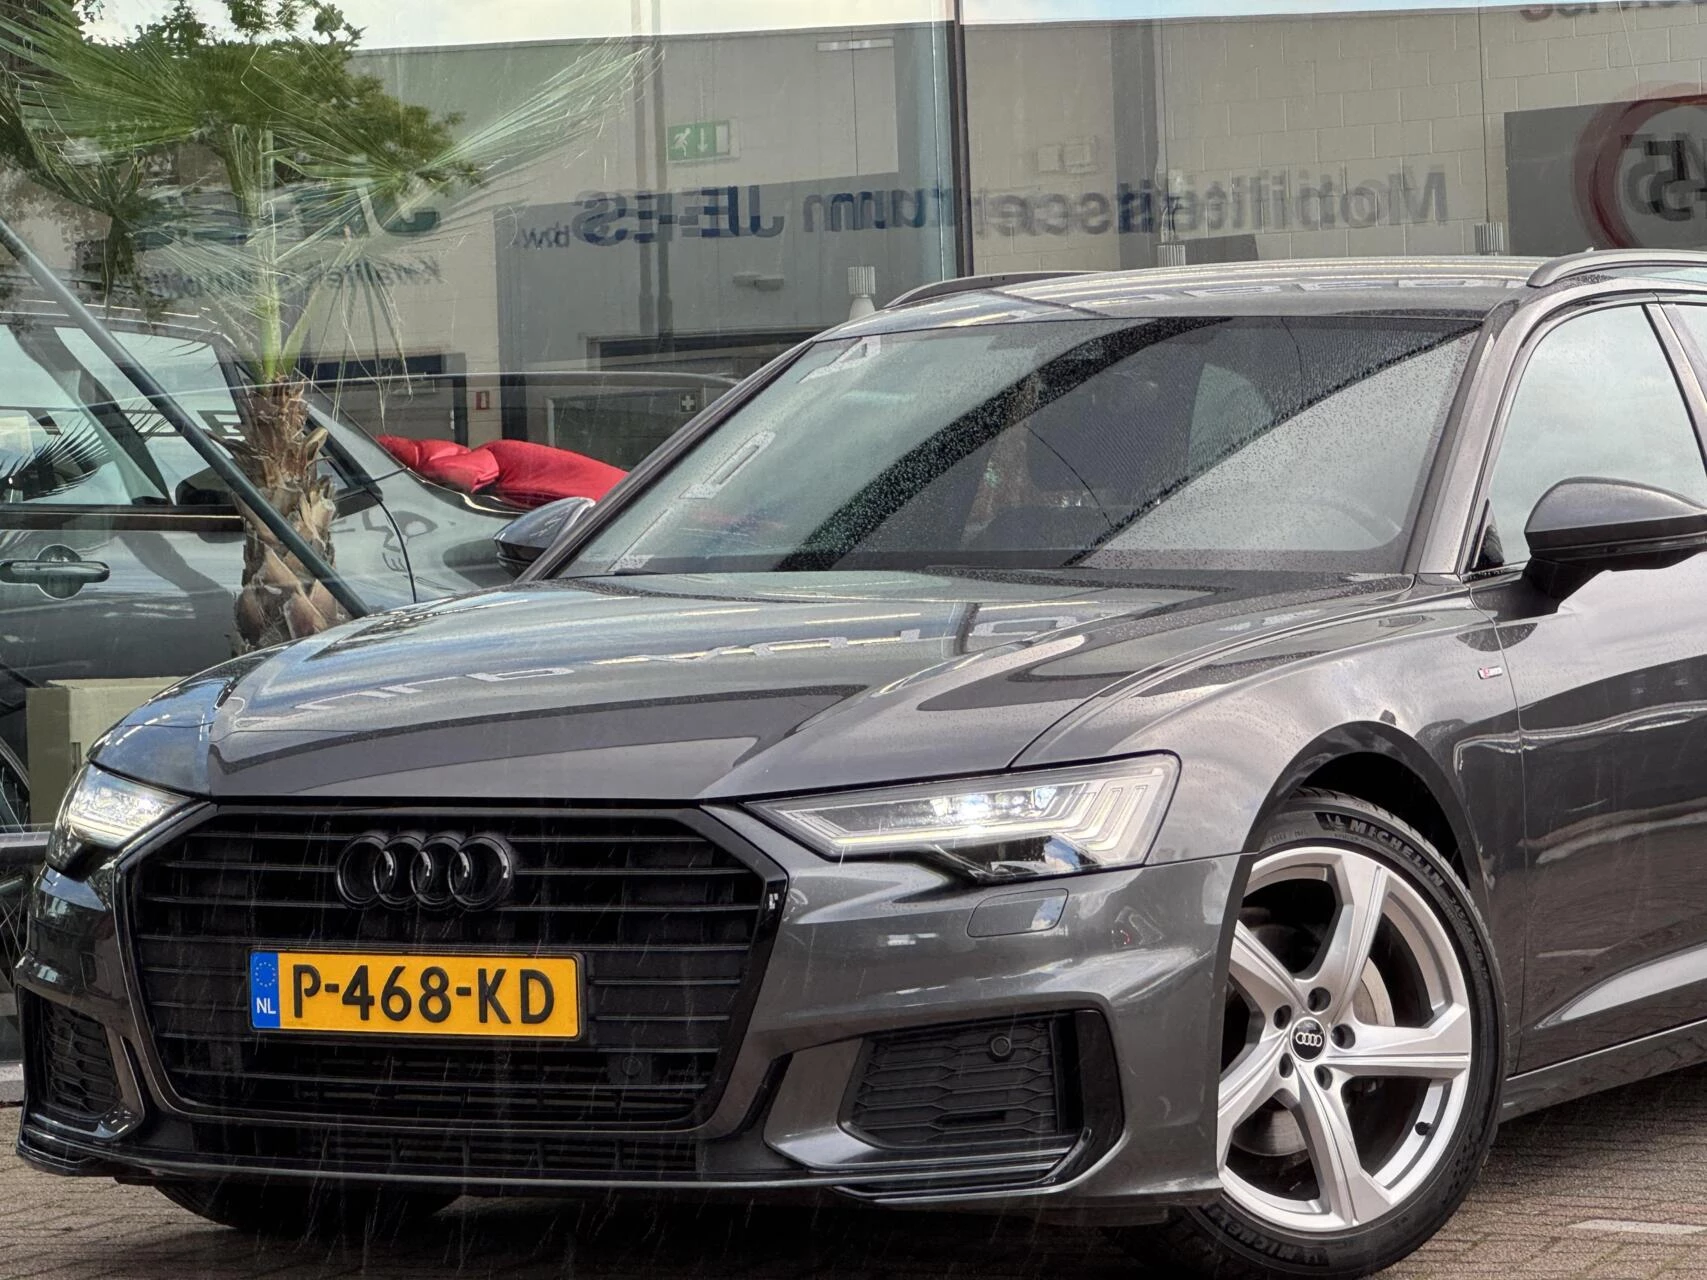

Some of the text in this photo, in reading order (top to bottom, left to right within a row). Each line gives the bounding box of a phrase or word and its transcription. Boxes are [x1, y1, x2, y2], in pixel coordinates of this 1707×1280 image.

[1350, 819, 1445, 887] MICHELIN
[256, 997, 276, 1015] NL
[292, 963, 555, 1025] P-468-KD
